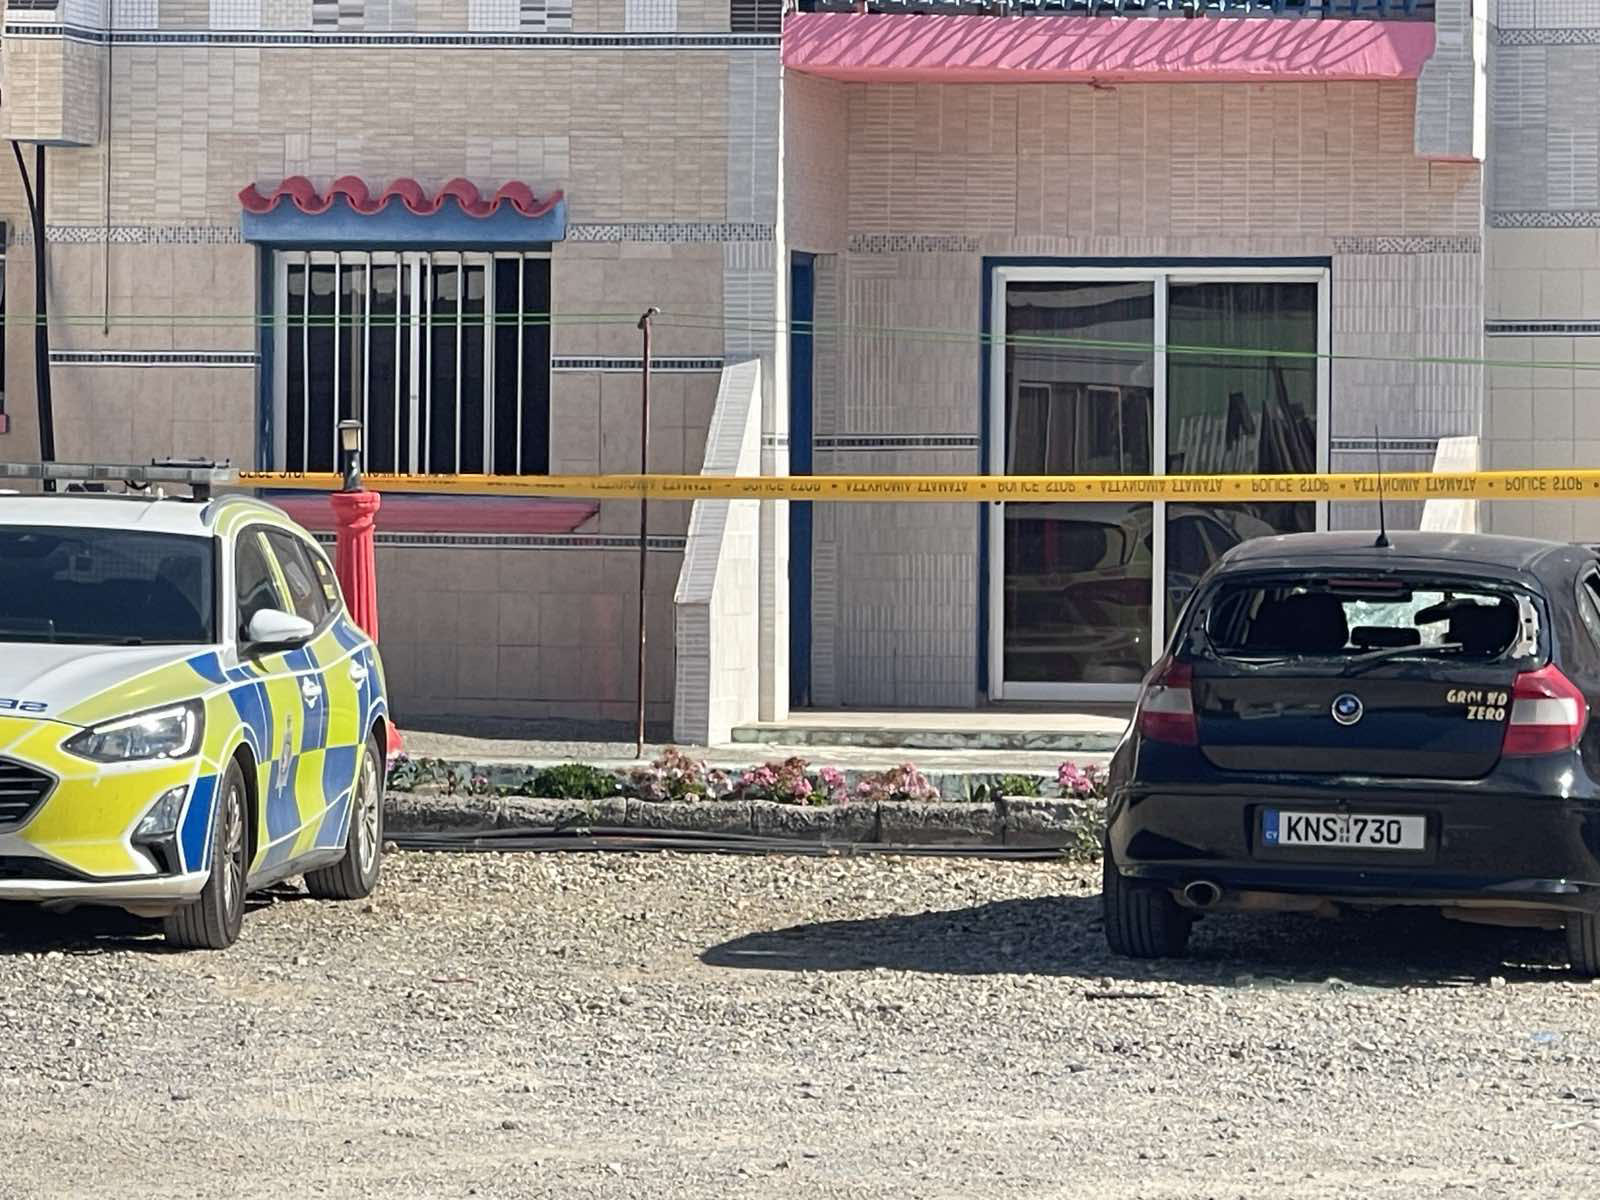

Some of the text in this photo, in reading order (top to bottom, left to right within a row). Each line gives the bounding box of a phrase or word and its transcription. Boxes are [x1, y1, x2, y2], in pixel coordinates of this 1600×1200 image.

[1466, 705, 1506, 721] ZERO
[1265, 830, 1278, 840] CY
[1286, 816, 1338, 842] KNS
[1353, 818, 1402, 845] 730
